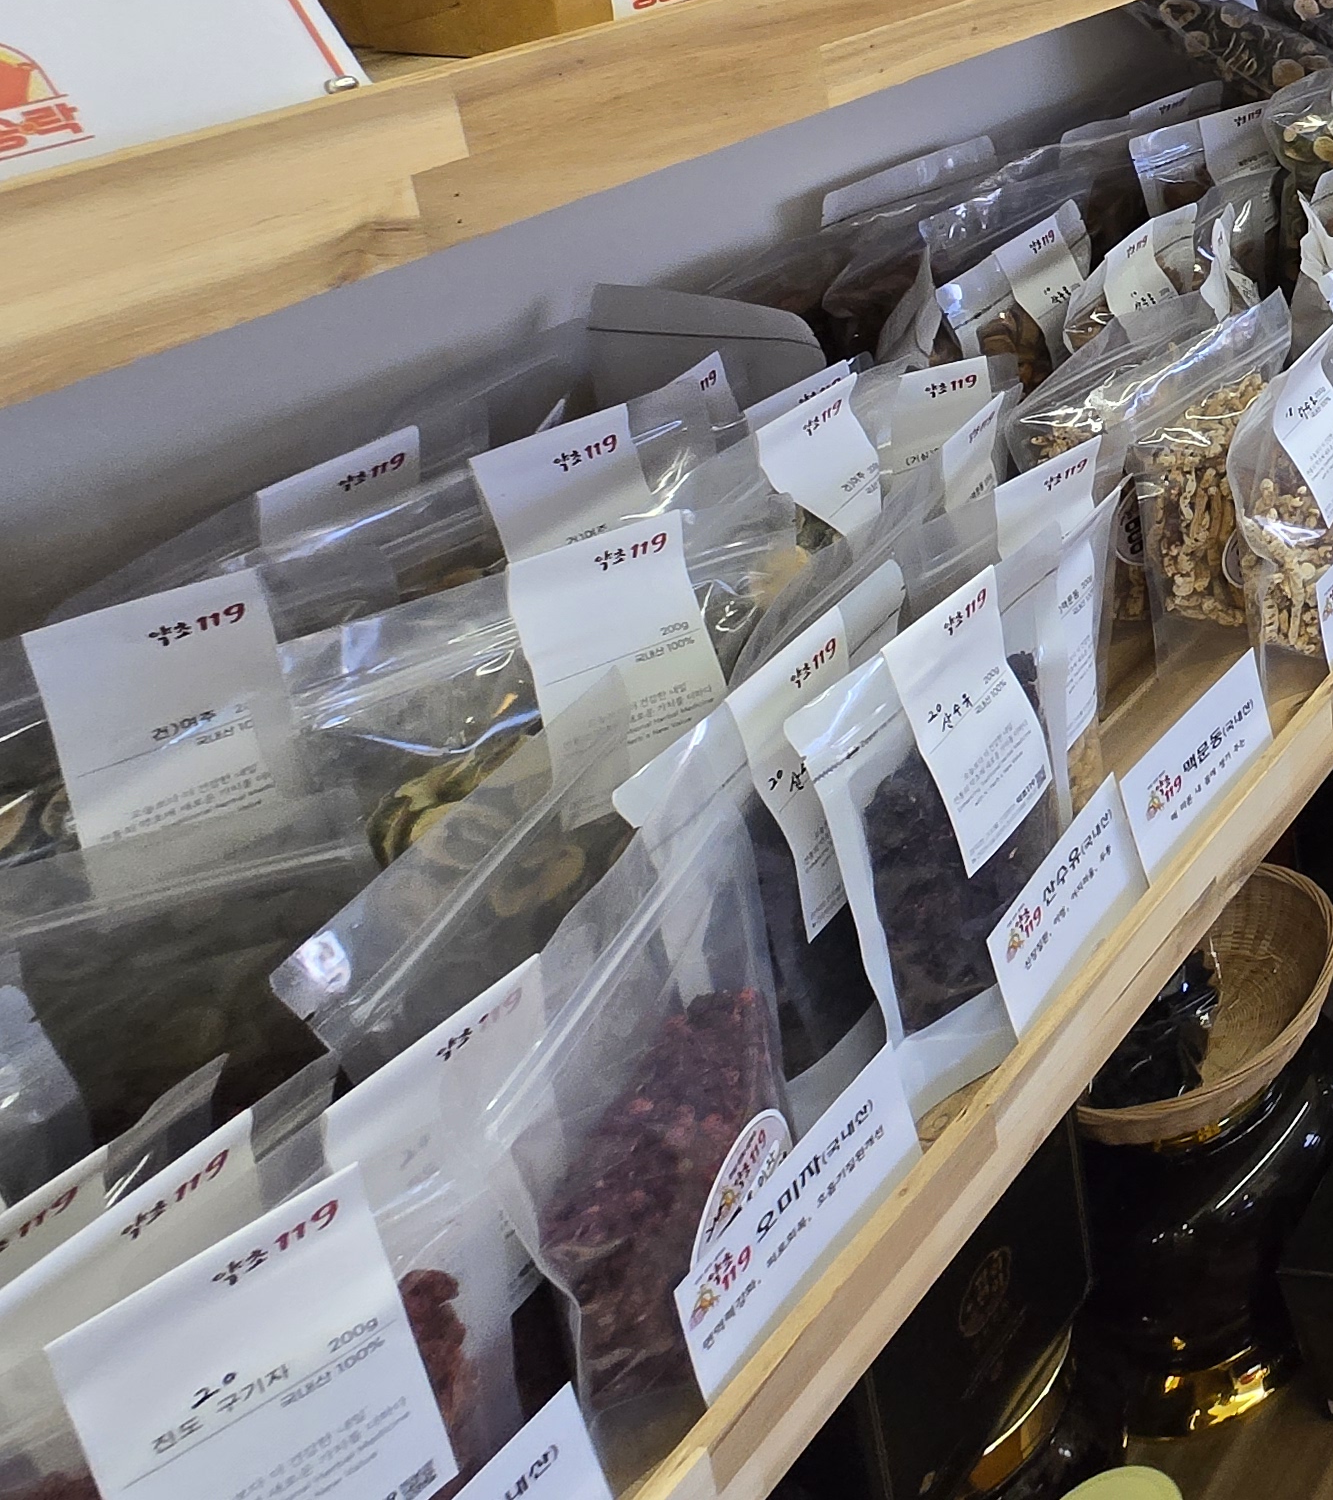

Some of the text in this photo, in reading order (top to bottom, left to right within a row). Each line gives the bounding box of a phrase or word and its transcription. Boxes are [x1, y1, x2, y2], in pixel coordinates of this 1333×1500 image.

[924, 374, 978, 399] 약초119
[802, 399, 842, 436] 약초119
[337, 452, 406, 492] 약초119
[553, 435, 618, 472] 약초119
[1043, 458, 1088, 491] 약초119
[593, 532, 668, 571] 약초119
[148, 603, 245, 646] 약초119
[659, 621, 690, 636] 200g
[943, 588, 987, 636] 약초119
[666, 635, 696, 653] 100%
[790, 637, 837, 688] 약초119
[196, 726, 234, 745] 국내산
[1183, 699, 1254, 772] 맥문동(국내산)
[1043, 809, 1113, 906] 산수유(국내산)
[120, 1148, 230, 1240] 약초119
[721, 1245, 752, 1292] 119
[756, 1099, 874, 1243] 오미자(국내산)
[210, 1199, 339, 1286] 약초119
[327, 1317, 378, 1354] 200g
[280, 1336, 387, 1409] 국내산 100%
[151, 1364, 289, 1455] 진도 구기자
